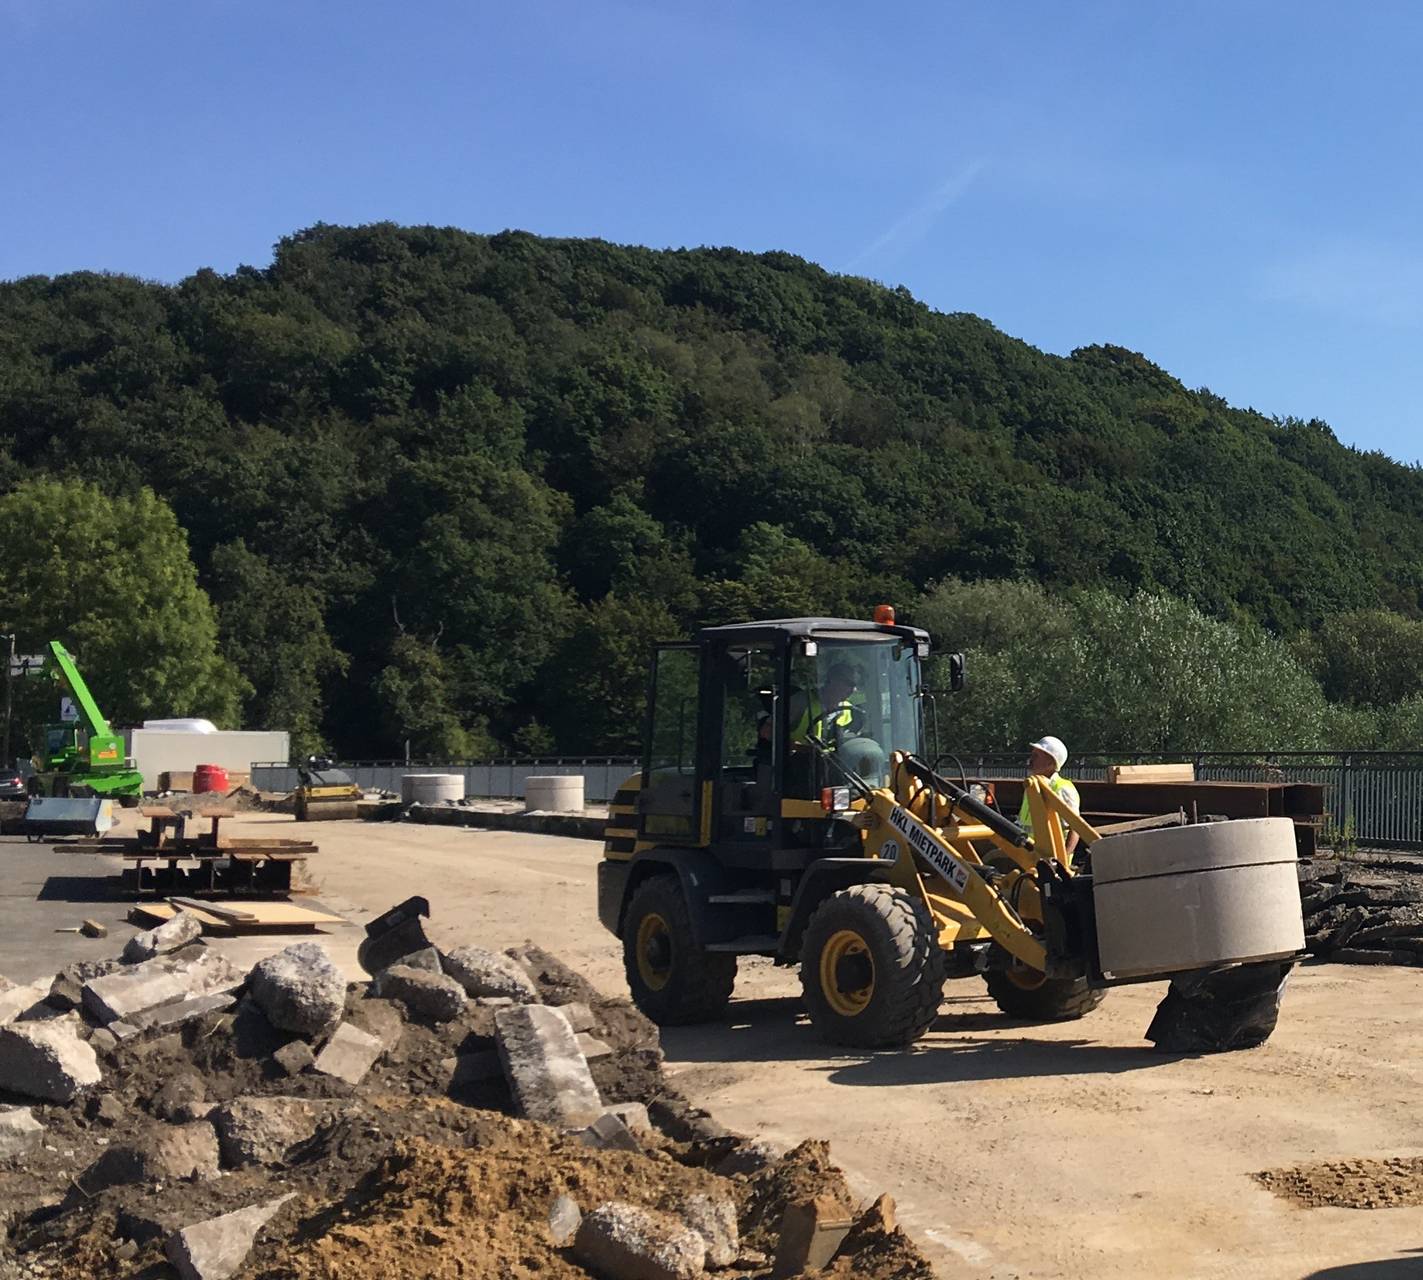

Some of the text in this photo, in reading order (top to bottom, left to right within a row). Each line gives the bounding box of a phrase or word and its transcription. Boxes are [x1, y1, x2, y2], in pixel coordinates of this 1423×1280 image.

[883, 844, 897, 859] 20
[890, 807, 957, 878] HKL MIETPARK
